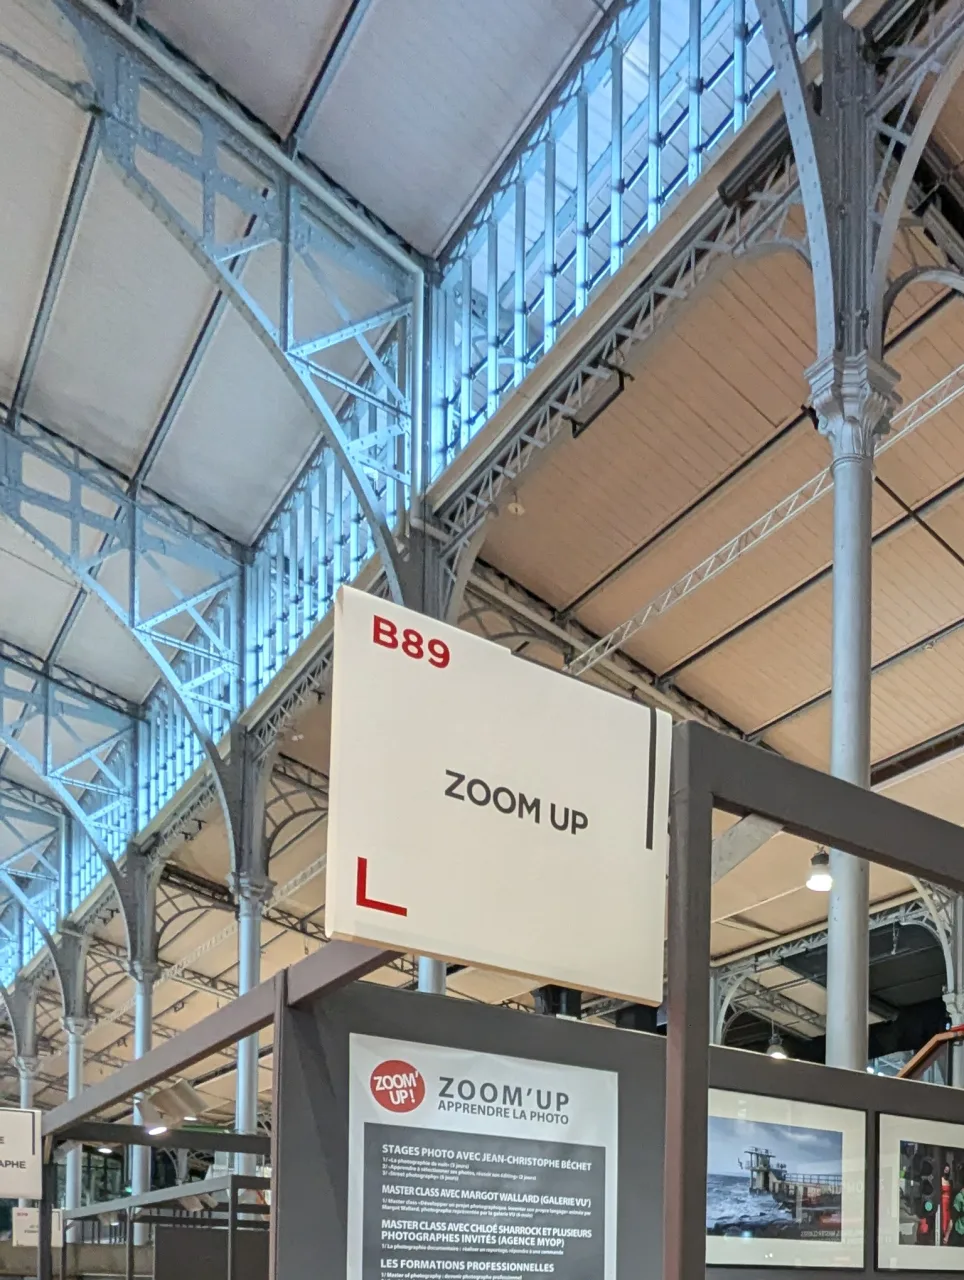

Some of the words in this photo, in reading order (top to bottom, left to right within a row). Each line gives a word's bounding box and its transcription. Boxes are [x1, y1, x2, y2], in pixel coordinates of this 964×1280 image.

[373, 615, 450, 668] B89
[444, 769, 540, 824] ZOOM
[550, 803, 589, 835] UP
[374, 1071, 419, 1091] ZOOM'
[389, 1089, 415, 1105] UP!
[438, 1100, 510, 1119] APPRENDRE
[513, 1109, 527, 1120] LA
[530, 1111, 569, 1125] PHOTO
[382, 1144, 420, 1156] STAGES
[421, 1147, 454, 1159] PHOTO
[456, 1151, 480, 1161] AVEC
[482, 1153, 560, 1168] JEAN-CHRISTOPHE
[561, 1159, 592, 1171] BÉCHET
[382, 1184, 414, 1196] MASTER
[415, 1187, 439, 1197] CLASS
[440, 1188, 460, 1199] AVEC
[461, 1190, 498, 1201] MARGOT
[500, 1192, 540, 1204] WALLARD
[381, 1219, 418, 1230] MASTER
[419, 1221, 446, 1231] CLASS
[447, 1222, 469, 1233] AVEC
[470, 1223, 498, 1234] CHLOÉ
[499, 1225, 541, 1236] SHARROCK
[542, 1227, 552, 1236] ET
[552, 1228, 592, 1238] PLUSIEURS
[381, 1231, 460, 1243] PHOTOGRAPHES
[461, 1233, 497, 1244] INVITÉS
[498, 1235, 535, 1246] (AGENCE
[537, 1237, 565, 1248] MYOP)
[380, 1258, 398, 1269] LES
[400, 1259, 465, 1270] FORMATIONS
[467, 1261, 555, 1273] PROFESSIONNELLES
